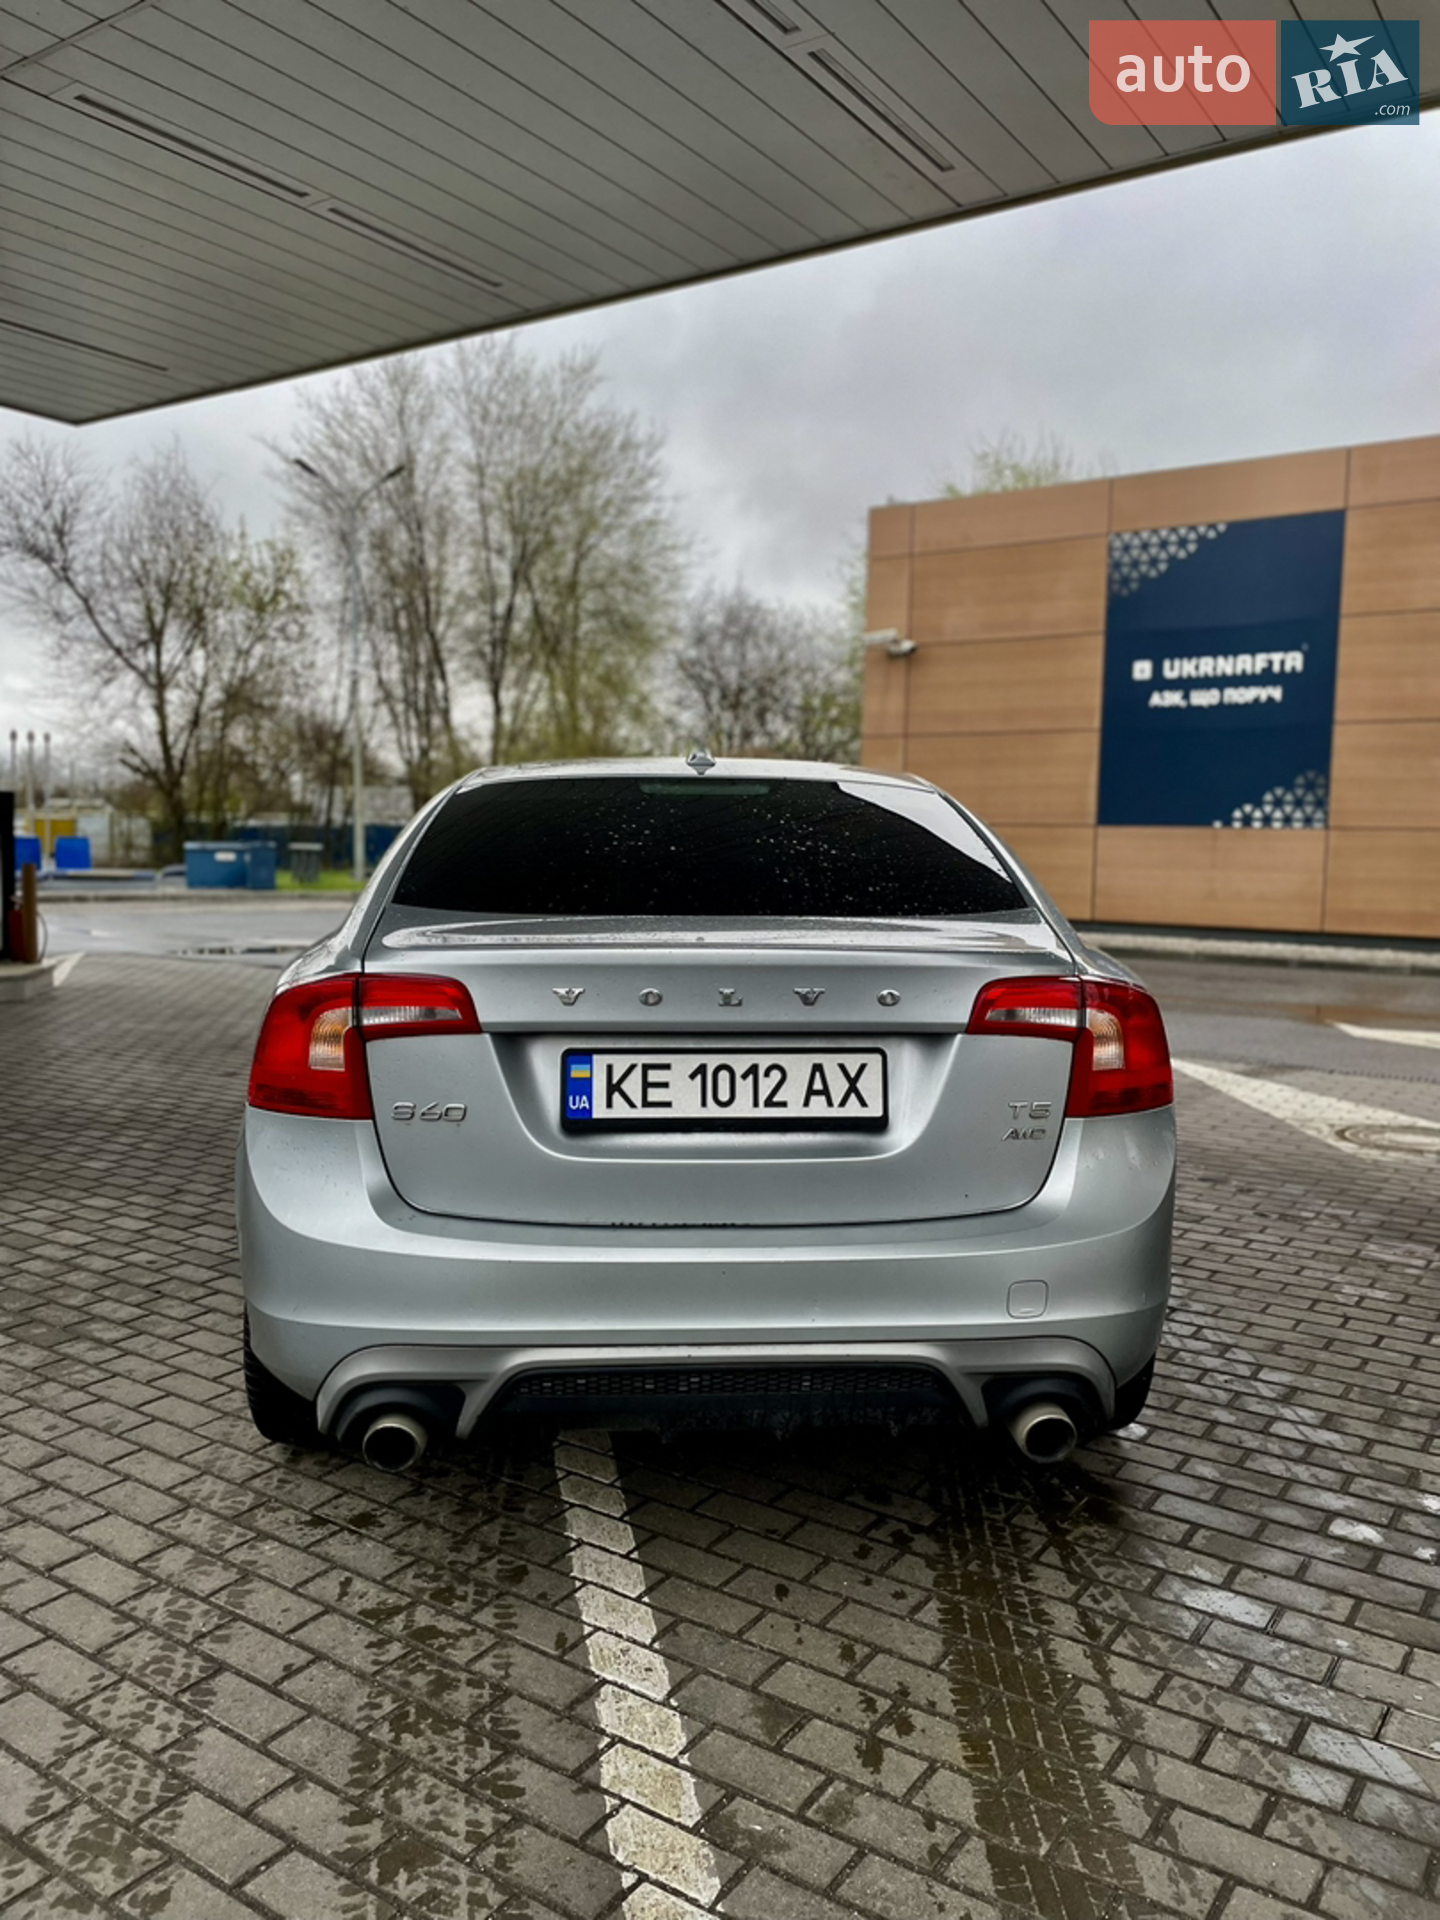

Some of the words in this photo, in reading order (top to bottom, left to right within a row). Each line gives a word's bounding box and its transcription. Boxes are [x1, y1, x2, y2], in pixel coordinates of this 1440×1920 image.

[1162, 651, 1304, 680] UKRNAFTA
[1223, 685, 1283, 705] ПОРУЧ
[552, 987, 902, 1007] VOLVO
[605, 1063, 673, 1110] KE
[687, 1063, 789, 1109] 1012
[802, 1063, 869, 1109] AX
[391, 1101, 467, 1122] S60
[568, 1094, 590, 1110] UA
[1008, 1101, 1052, 1120] T5
